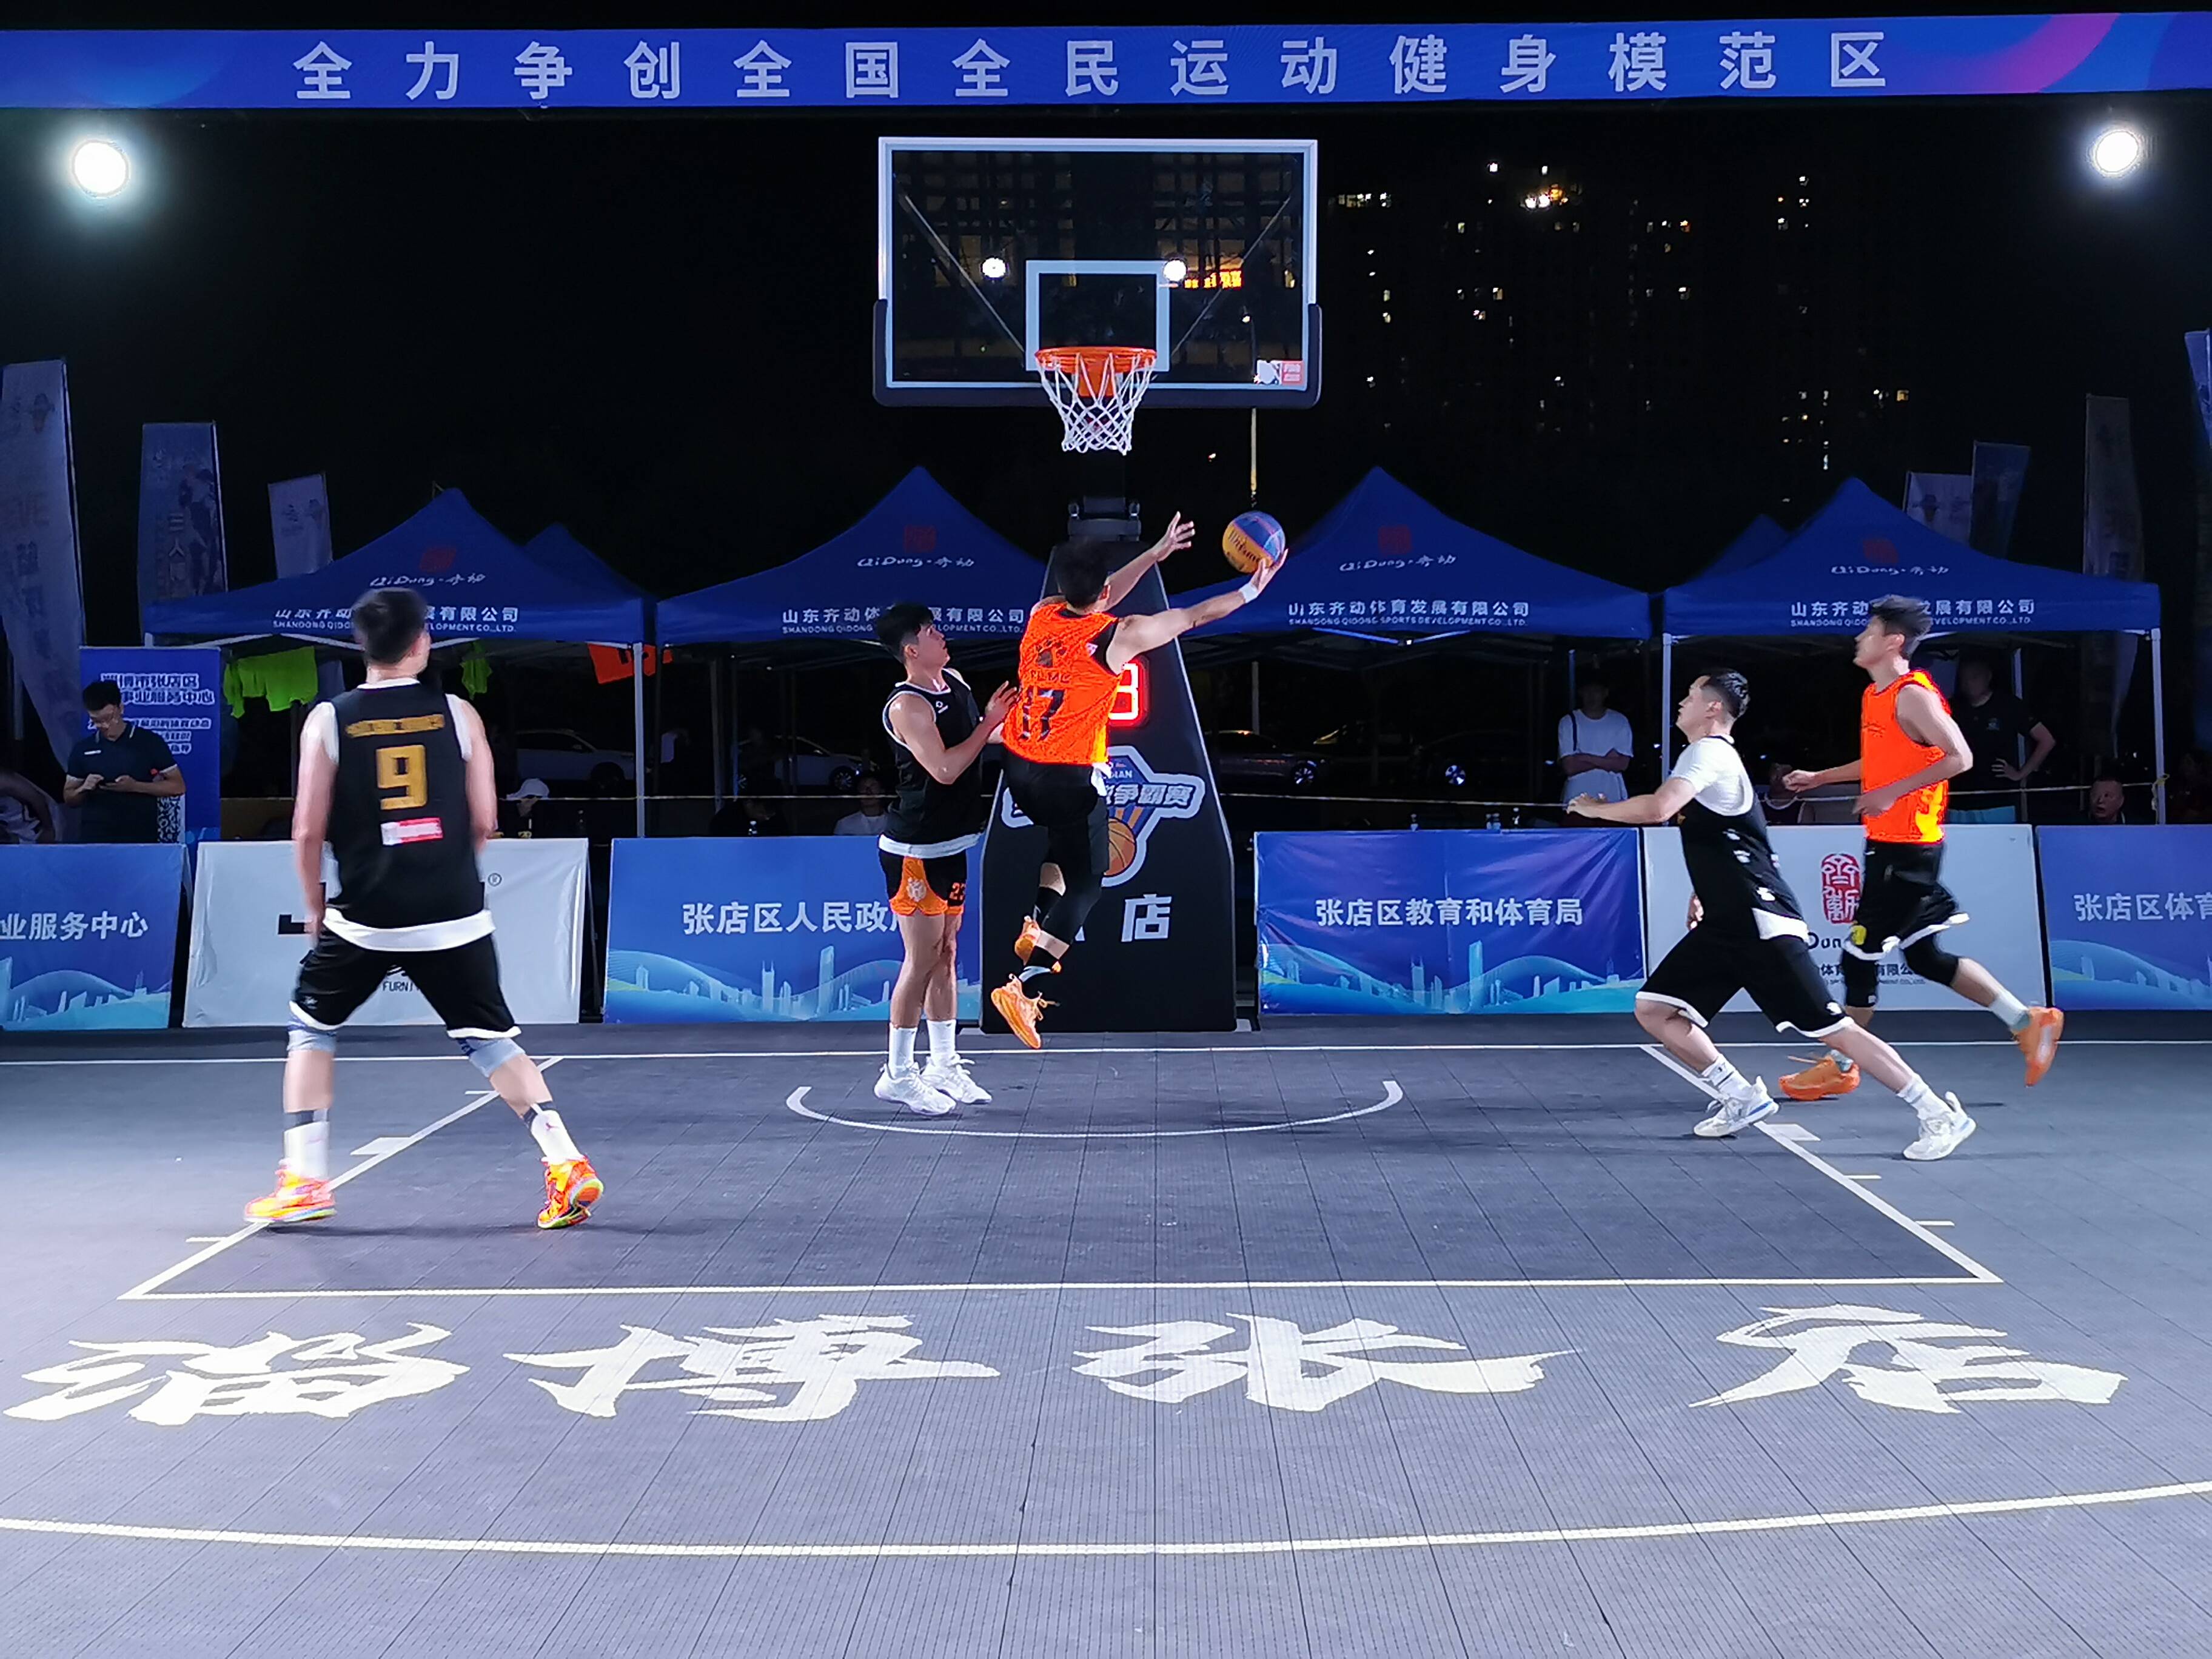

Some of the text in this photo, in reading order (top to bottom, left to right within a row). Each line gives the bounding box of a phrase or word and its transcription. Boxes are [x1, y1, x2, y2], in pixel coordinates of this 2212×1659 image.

[294, 30, 1887, 100] 全力争创全国全民运动健身模范区
[375, 745, 427, 810] 9
[0, 911, 149, 940] 业服务中心
[1315, 897, 1583, 927] 张店区教育和体育局
